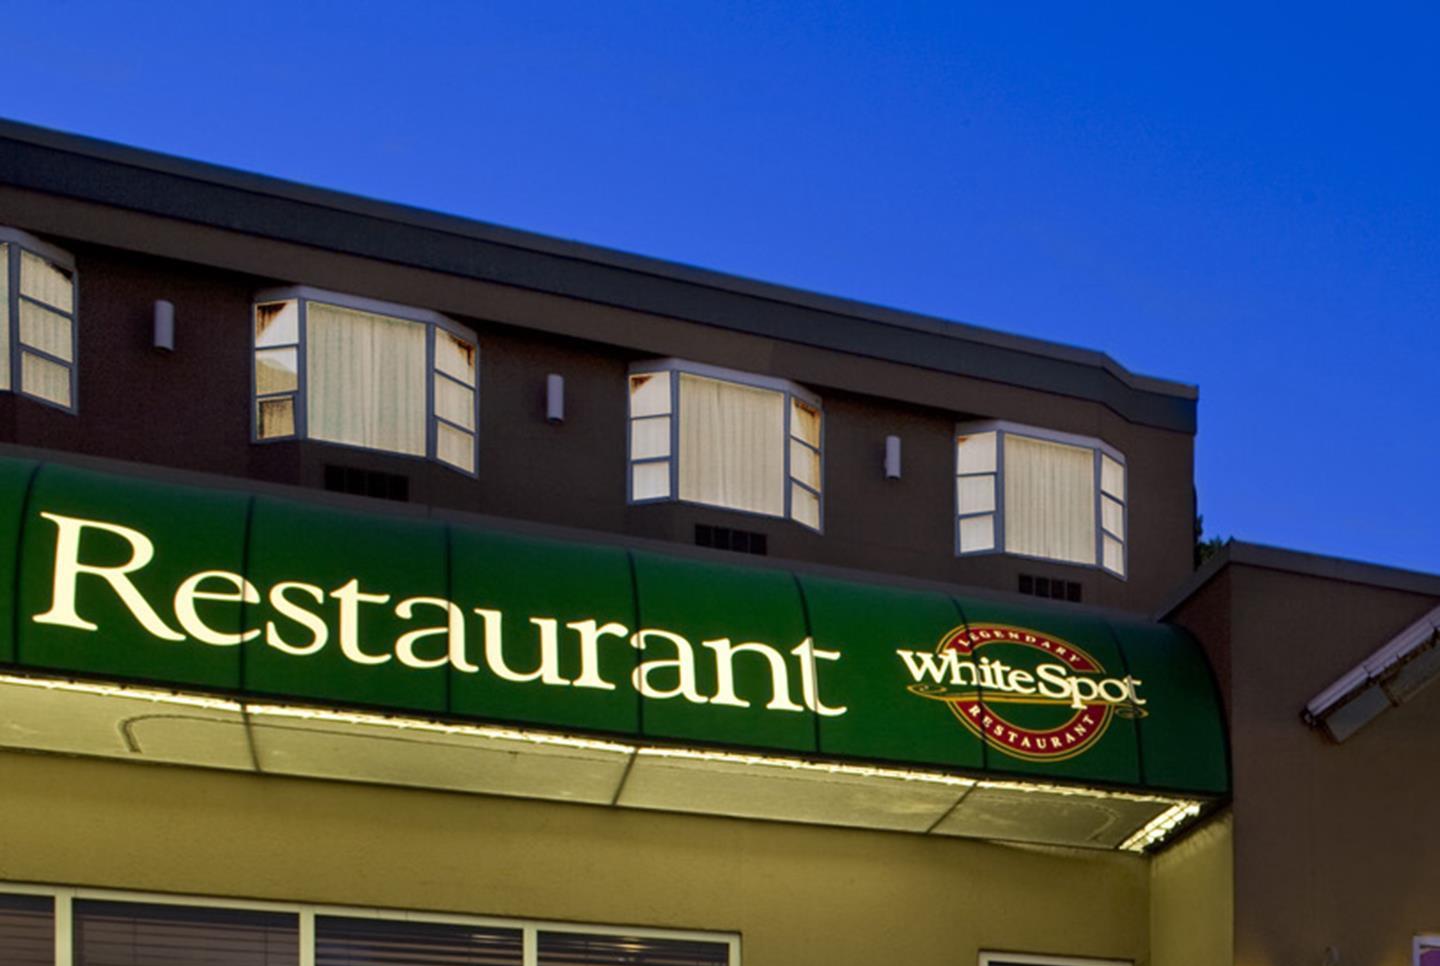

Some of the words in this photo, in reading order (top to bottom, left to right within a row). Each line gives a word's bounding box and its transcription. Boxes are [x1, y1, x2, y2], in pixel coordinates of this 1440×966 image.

[33, 511, 847, 717] Restaurant
[959, 630, 1080, 662] LEGENDARY
[969, 705, 1094, 749] RESTAURANT
